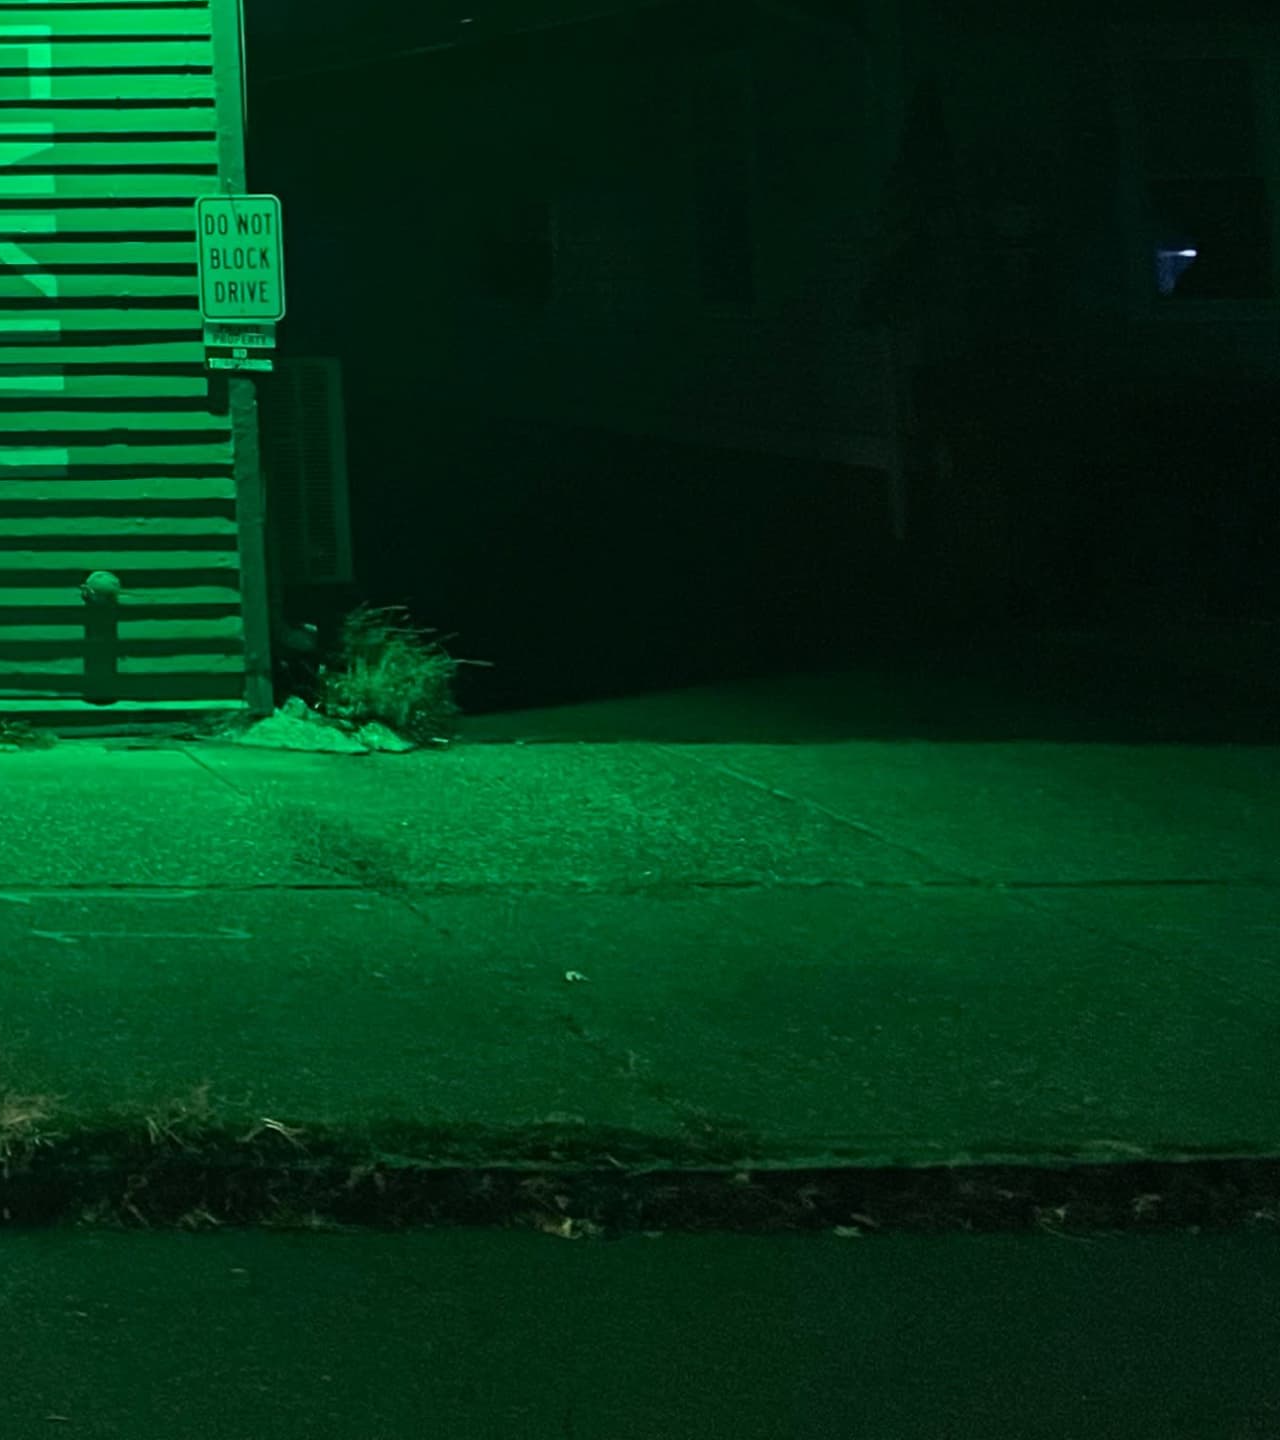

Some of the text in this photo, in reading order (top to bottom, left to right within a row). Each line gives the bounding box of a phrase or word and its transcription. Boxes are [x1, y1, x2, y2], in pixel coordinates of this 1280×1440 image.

[204, 212, 272, 236] DO NOT
[210, 247, 271, 269] BLOCK
[214, 280, 269, 303] DRIVE
